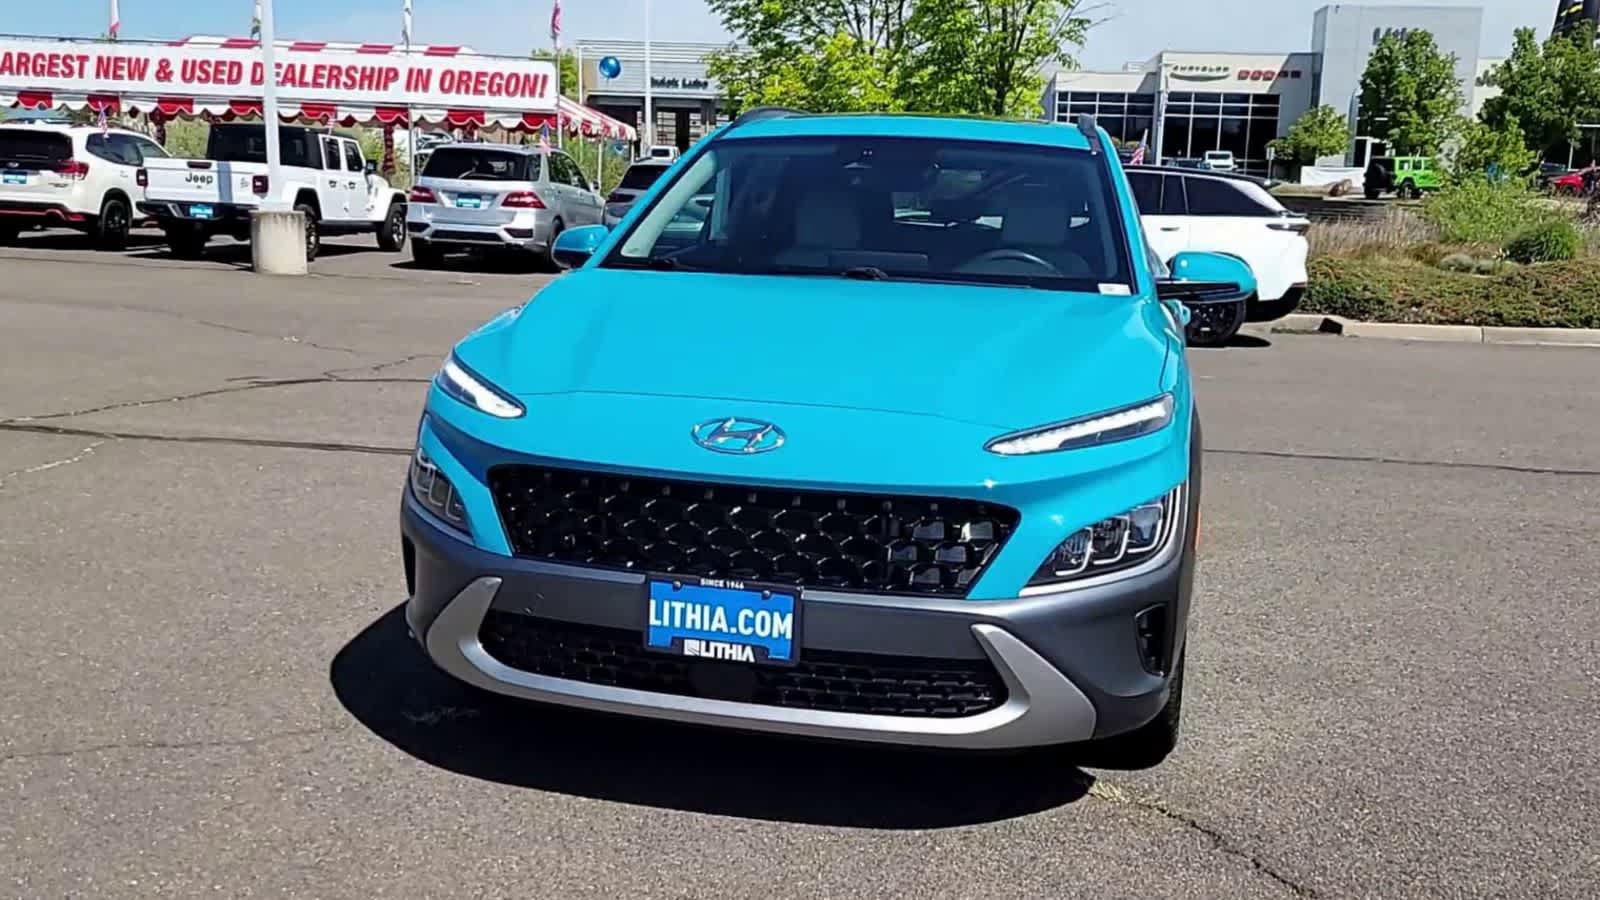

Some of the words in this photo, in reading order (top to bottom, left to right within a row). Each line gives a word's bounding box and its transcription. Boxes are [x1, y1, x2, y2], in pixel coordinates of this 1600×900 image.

[95, 55, 150, 82] NEW
[155, 58, 174, 83] &
[181, 59, 243, 85] USED
[405, 68, 432, 93] IN
[439, 70, 549, 98] OREGON!
[185, 173, 213, 184] Jeep
[700, 578, 724, 588] SINCE
[650, 599, 793, 640] LITHIA.COM
[701, 641, 755, 662] LITHIA
